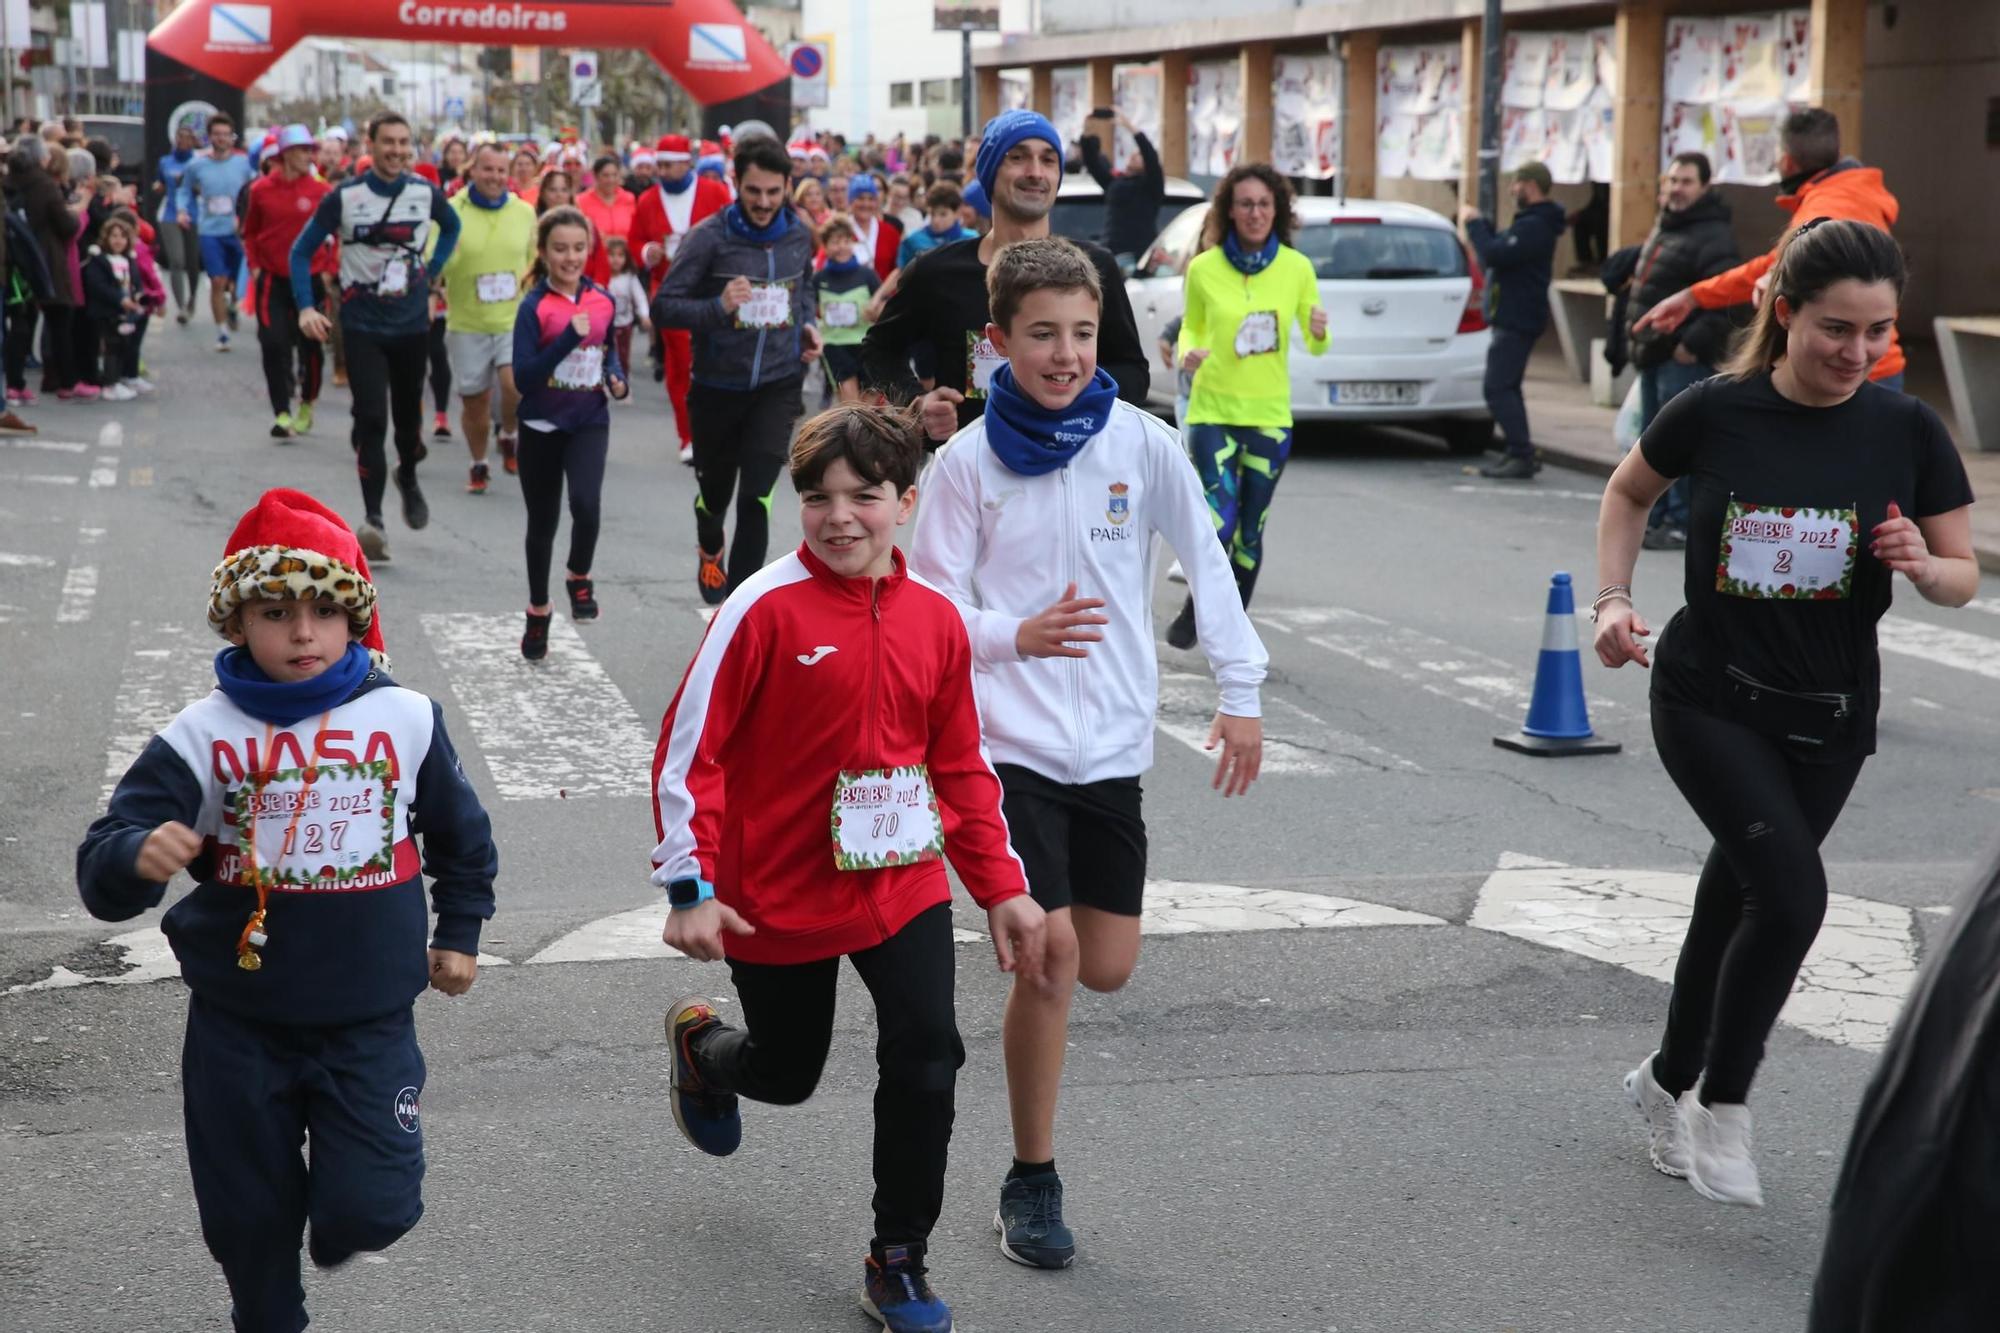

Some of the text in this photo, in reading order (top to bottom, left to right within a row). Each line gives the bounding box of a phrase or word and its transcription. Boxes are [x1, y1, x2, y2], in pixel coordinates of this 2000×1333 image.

[399, 0, 567, 30] Corredoiras
[1800, 530, 1837, 544] 2023
[1774, 550, 1792, 574] 2
[213, 730, 400, 784] NASA
[329, 792, 371, 812] 2023
[896, 785, 920, 804] 2023
[284, 821, 348, 854] 127
[872, 812, 899, 838] 70
